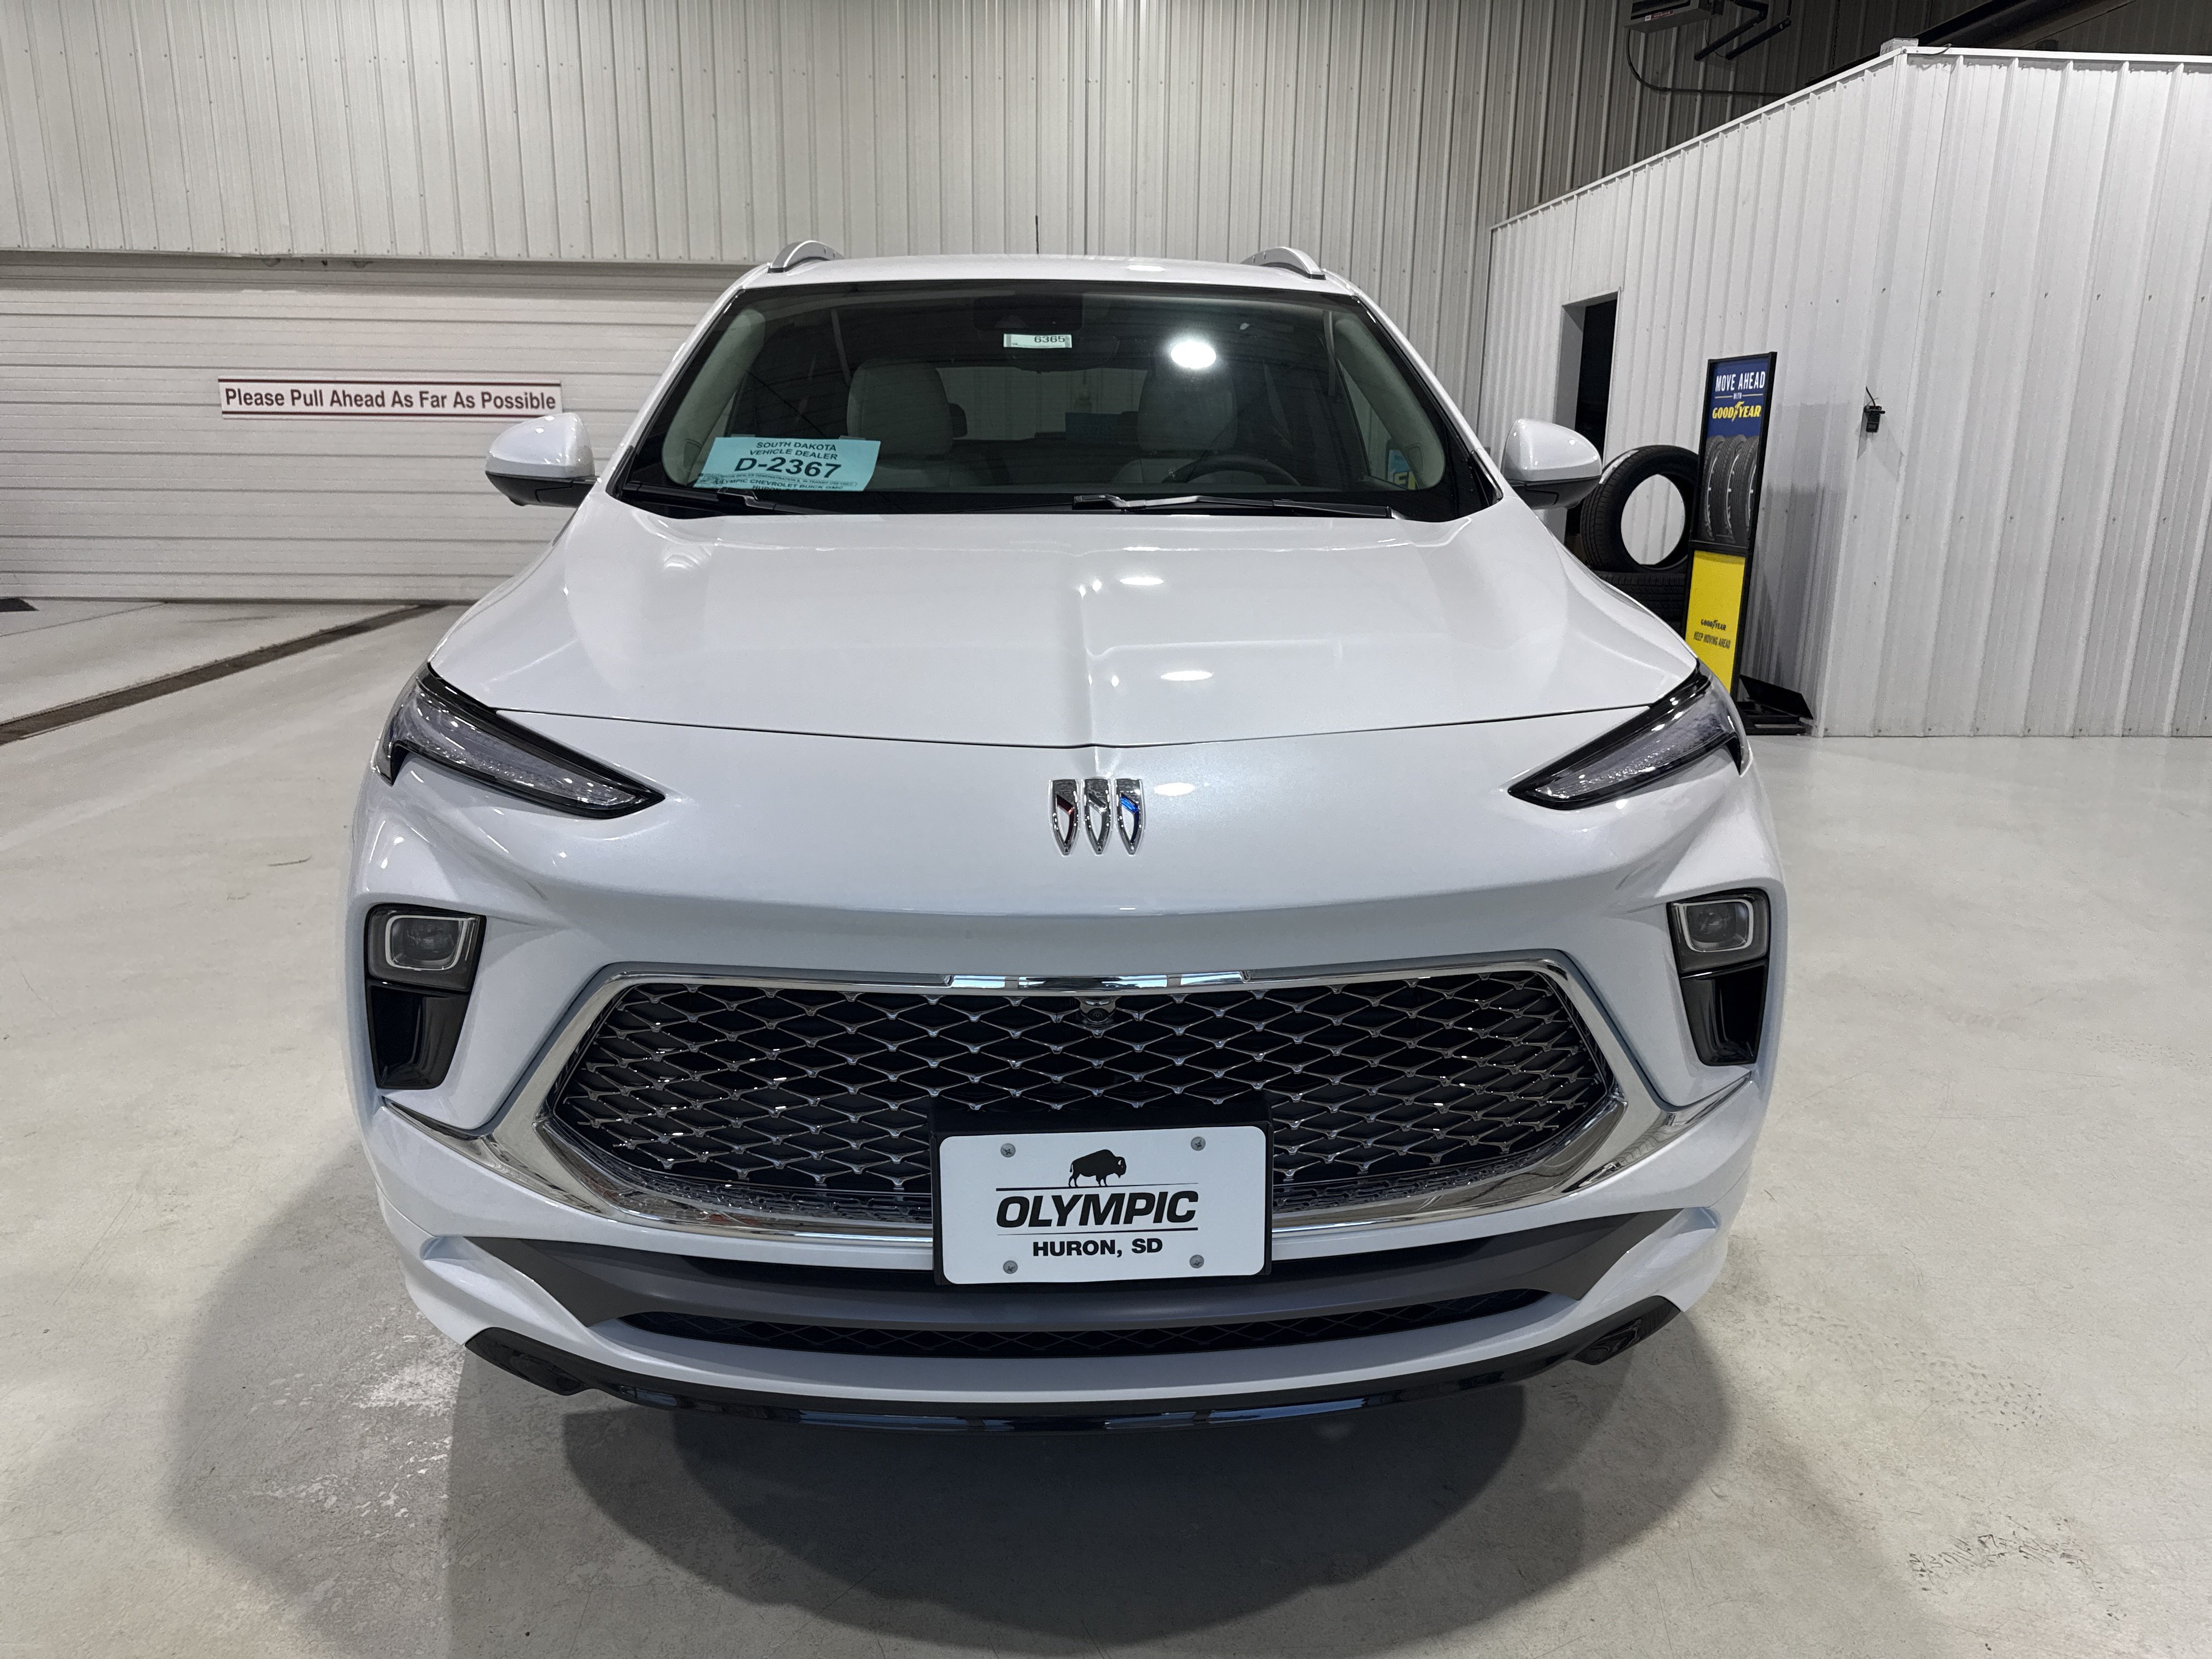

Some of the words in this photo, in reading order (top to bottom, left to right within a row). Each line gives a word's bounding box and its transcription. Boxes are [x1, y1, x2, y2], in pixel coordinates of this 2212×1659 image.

[1715, 374, 1736, 392] MOVE
[1737, 371, 1765, 390] AHEAD
[225, 388, 285, 406] Please
[290, 390, 323, 407] Pull
[330, 390, 386, 408] Ahead
[391, 391, 414, 409] As
[419, 391, 447, 409] Far
[453, 392, 476, 409] As
[481, 392, 556, 410] Possible
[1712, 402, 1762, 421] GOODYEAR
[794, 442, 837, 452] DAKOTA
[795, 450, 838, 460] DEALER
[734, 456, 842, 478] D-2367
[750, 478, 798, 488] CHEVROLET
[996, 1190, 1199, 1228] OLYMPIC
[1032, 1239, 1122, 1258] HURON,
[1131, 1238, 1163, 1254] SD
